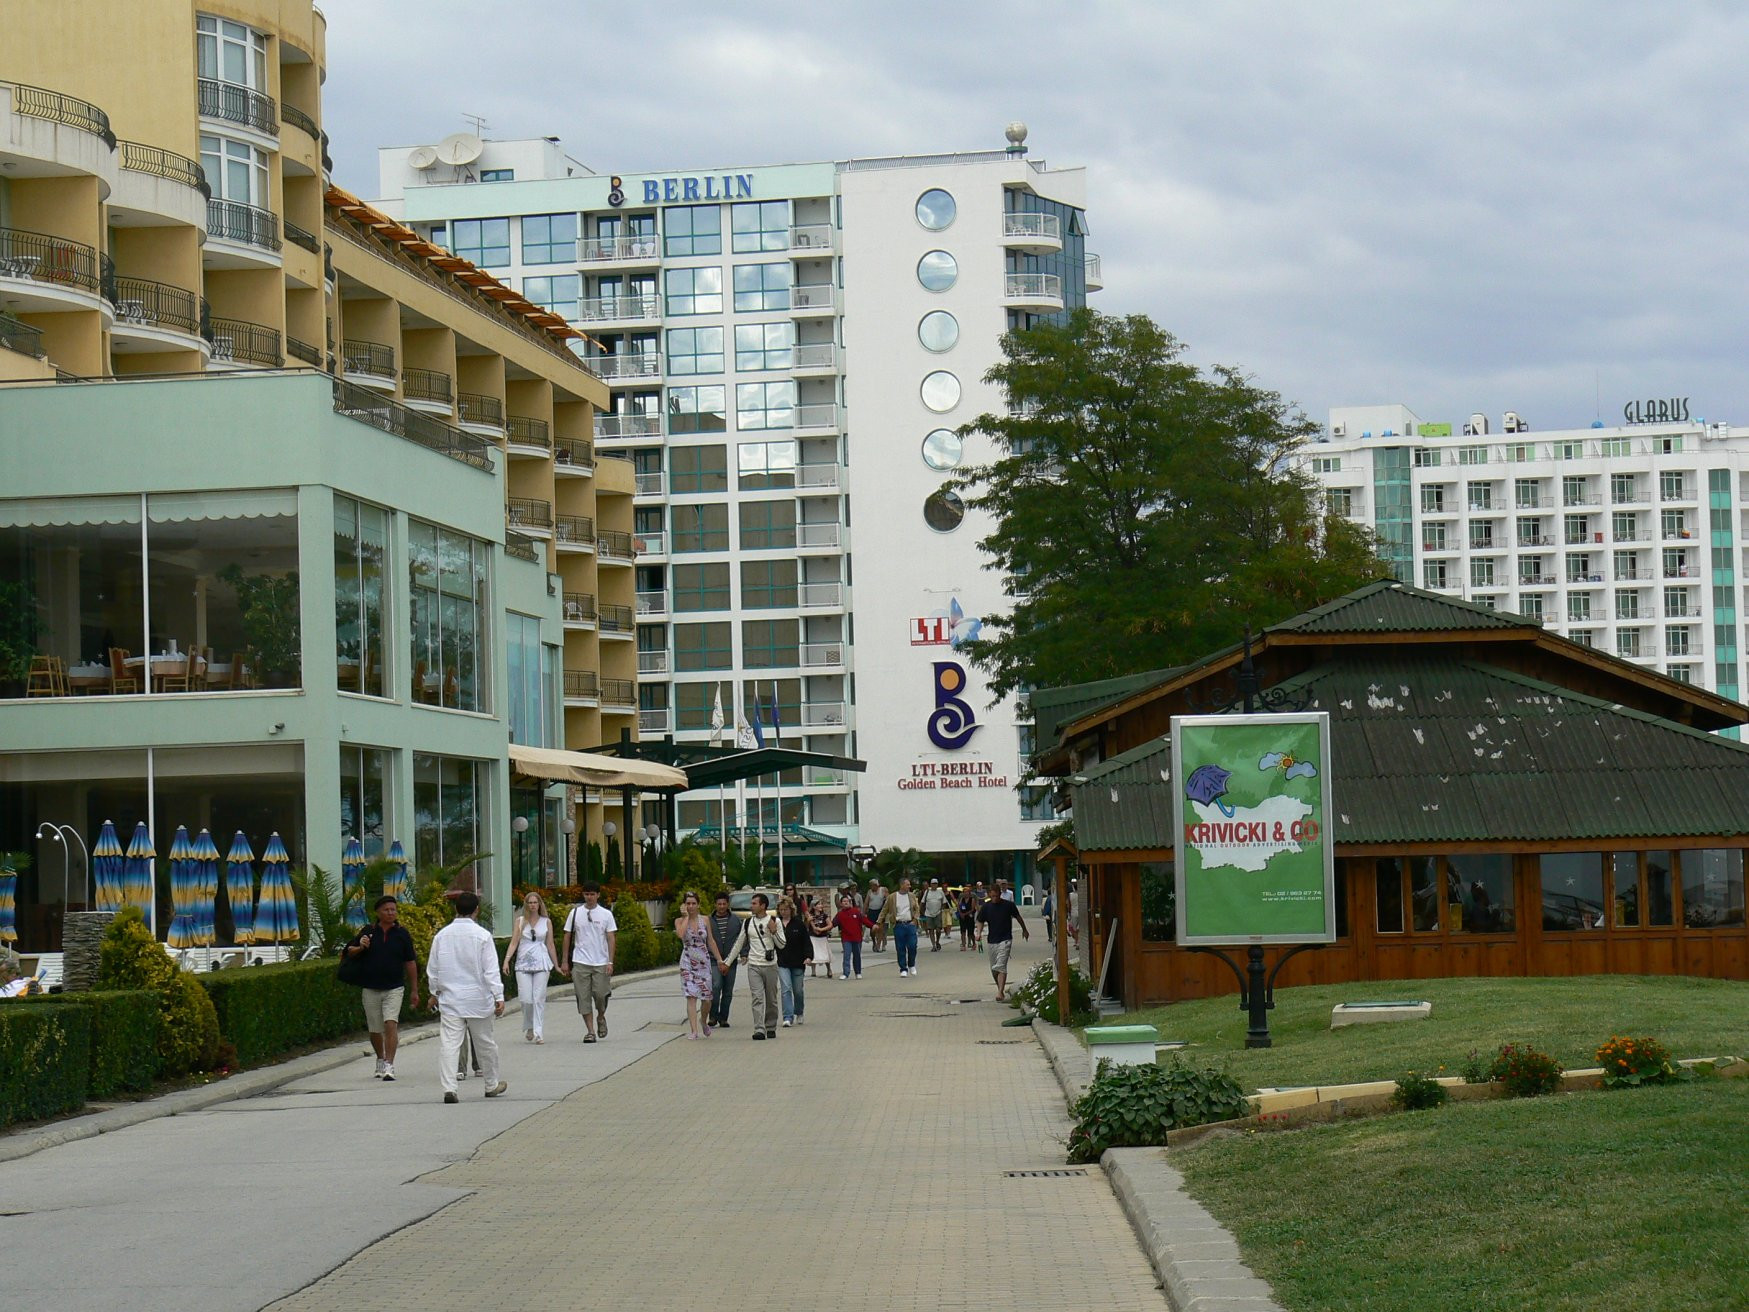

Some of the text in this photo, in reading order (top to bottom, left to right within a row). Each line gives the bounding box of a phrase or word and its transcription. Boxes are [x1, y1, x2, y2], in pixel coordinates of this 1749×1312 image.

[642, 174, 753, 203] BERLIN
[1624, 397, 1689, 423] GLARUS
[910, 618, 949, 641] LTI
[912, 762, 993, 777] LTI-BERLIN
[898, 775, 1007, 790] Golden Beach Hotel
[1185, 820, 1319, 843] KRIVICKI & CO
